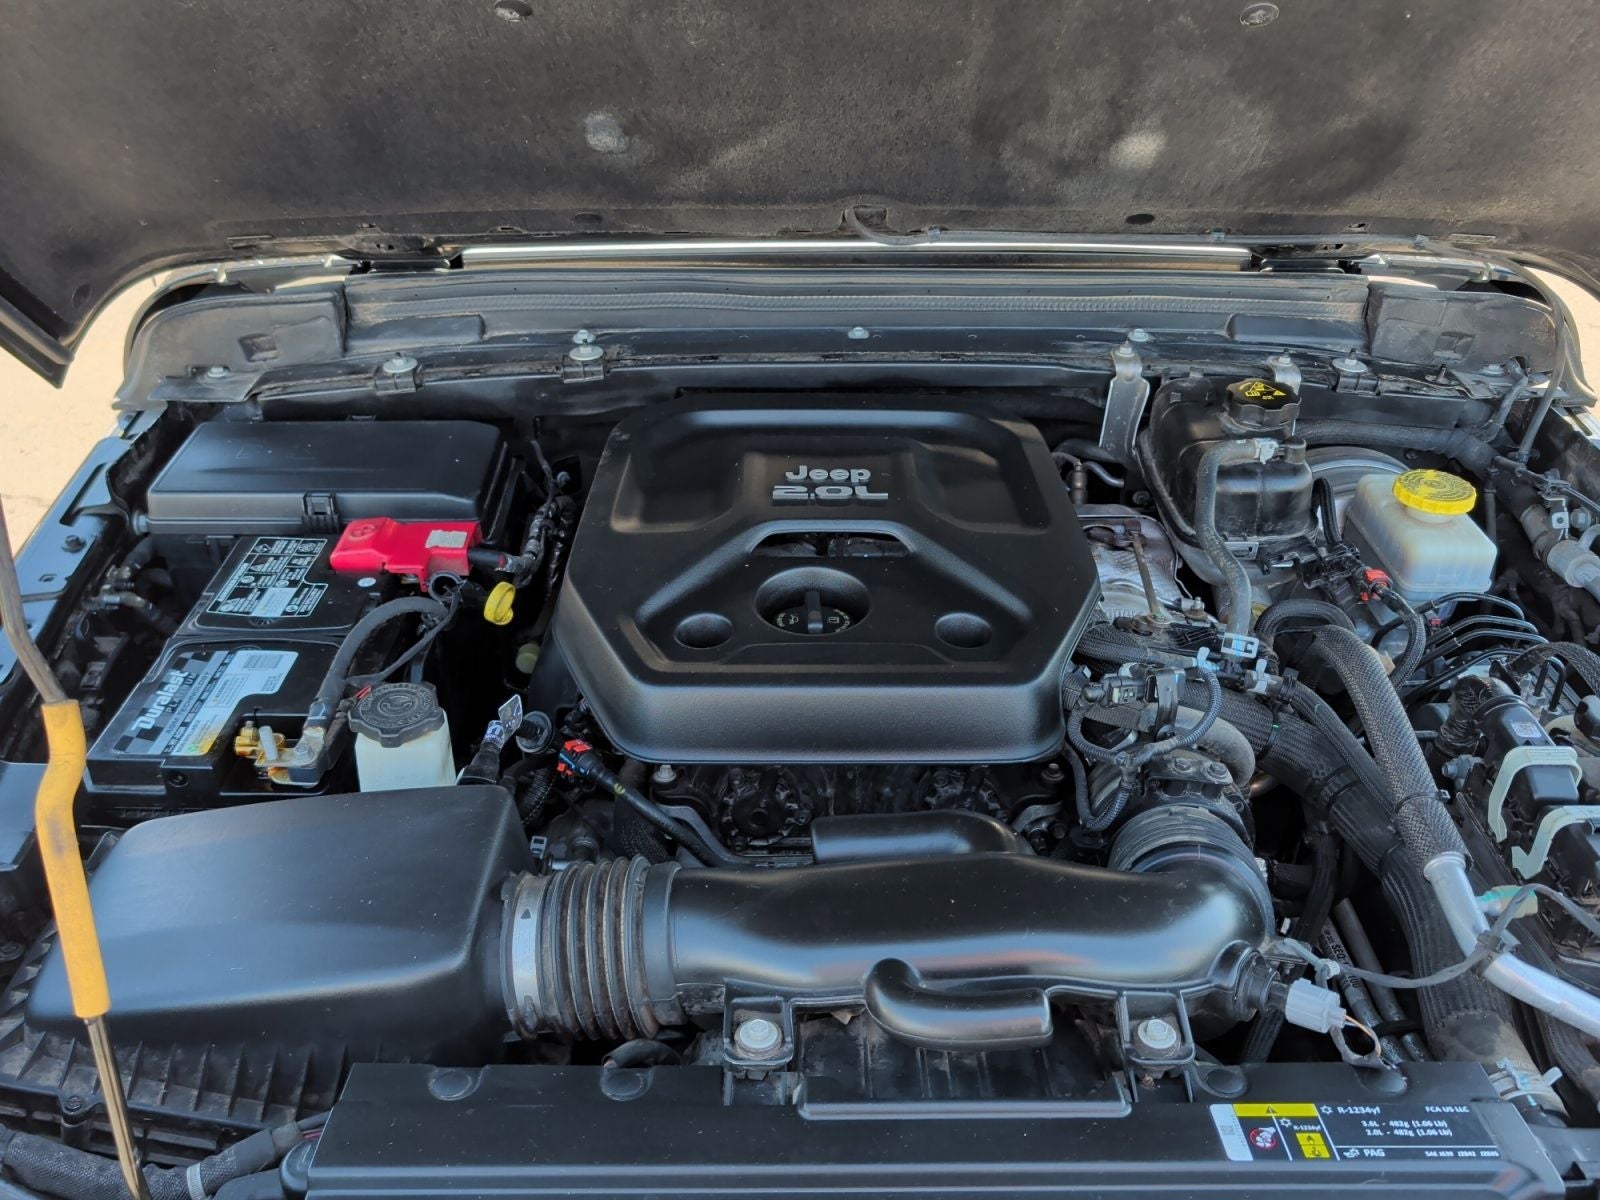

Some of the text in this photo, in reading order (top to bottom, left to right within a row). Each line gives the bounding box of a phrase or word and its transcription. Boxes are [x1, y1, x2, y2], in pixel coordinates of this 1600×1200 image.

[785, 465, 871, 483] Jeep
[772, 485, 889, 500] 2.0L
[130, 669, 189, 731] Duralast
[165, 672, 198, 713] PLATINUM
[1336, 1106, 1381, 1115] R-1234yf
[1363, 1149, 1386, 1157] PAG
